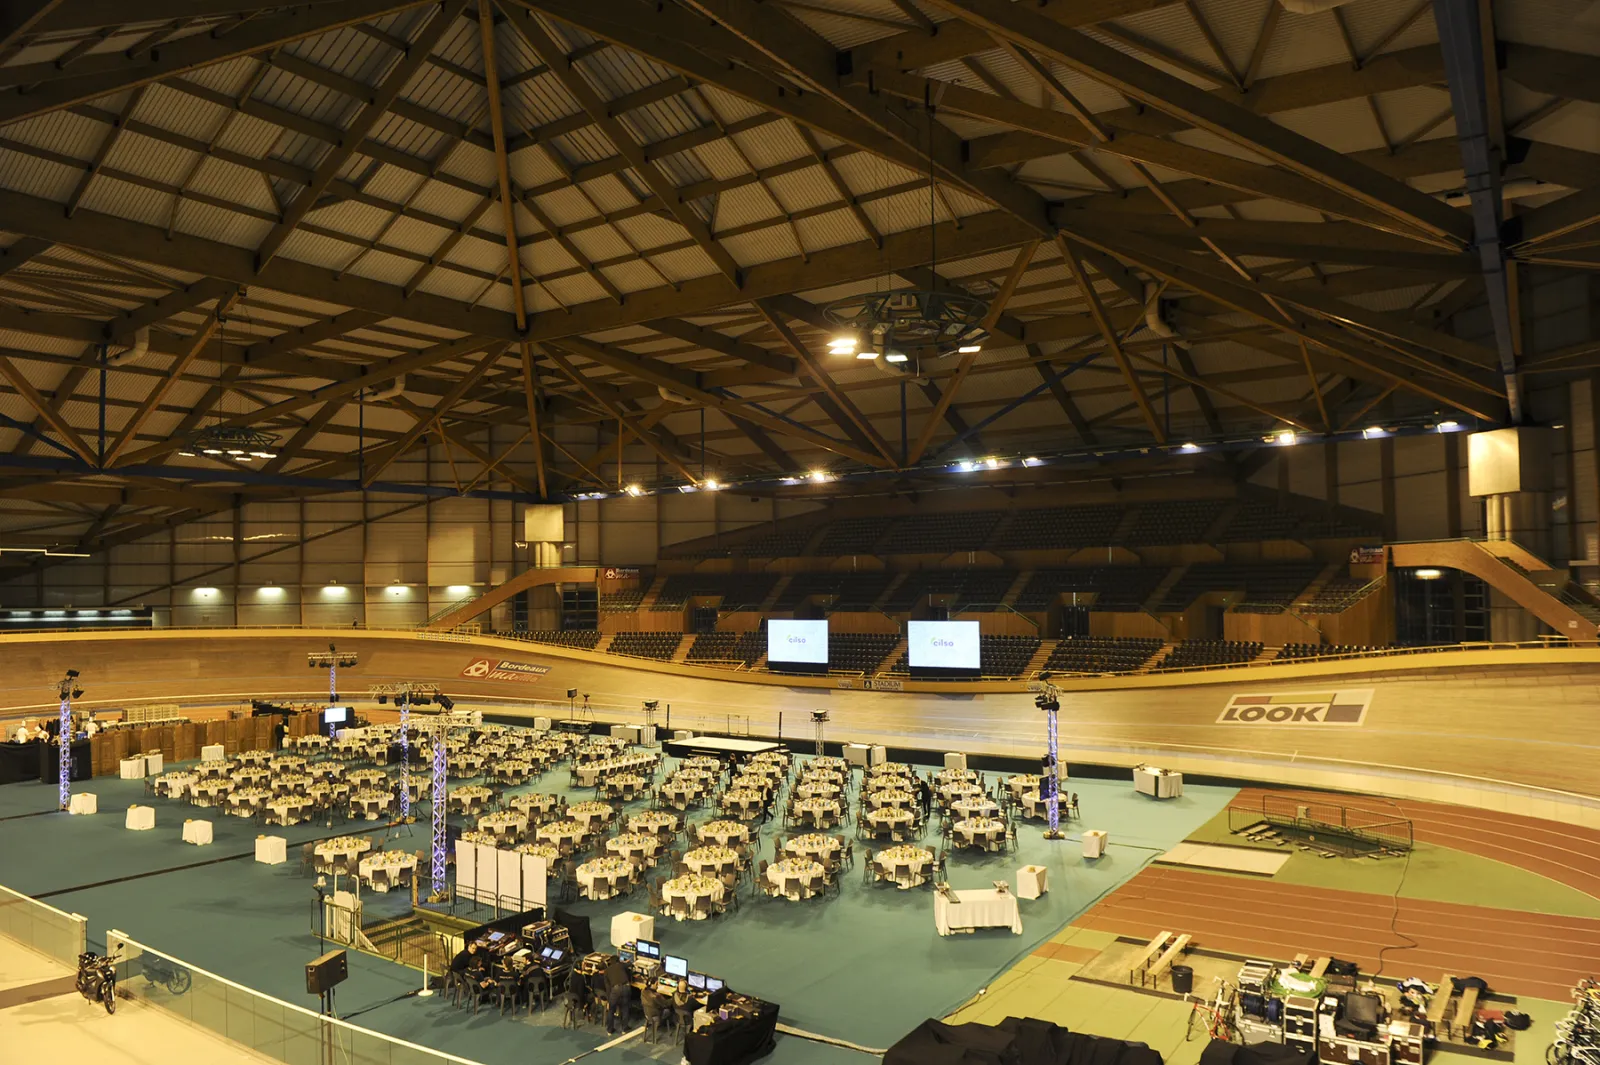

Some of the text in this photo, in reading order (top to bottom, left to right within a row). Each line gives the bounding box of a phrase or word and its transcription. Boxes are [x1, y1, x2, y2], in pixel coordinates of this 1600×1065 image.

[788, 636, 807, 644] cilso
[932, 639, 954, 647] cilso
[500, 661, 549, 674] Bordeaux
[1222, 706, 1324, 722] LOOK
